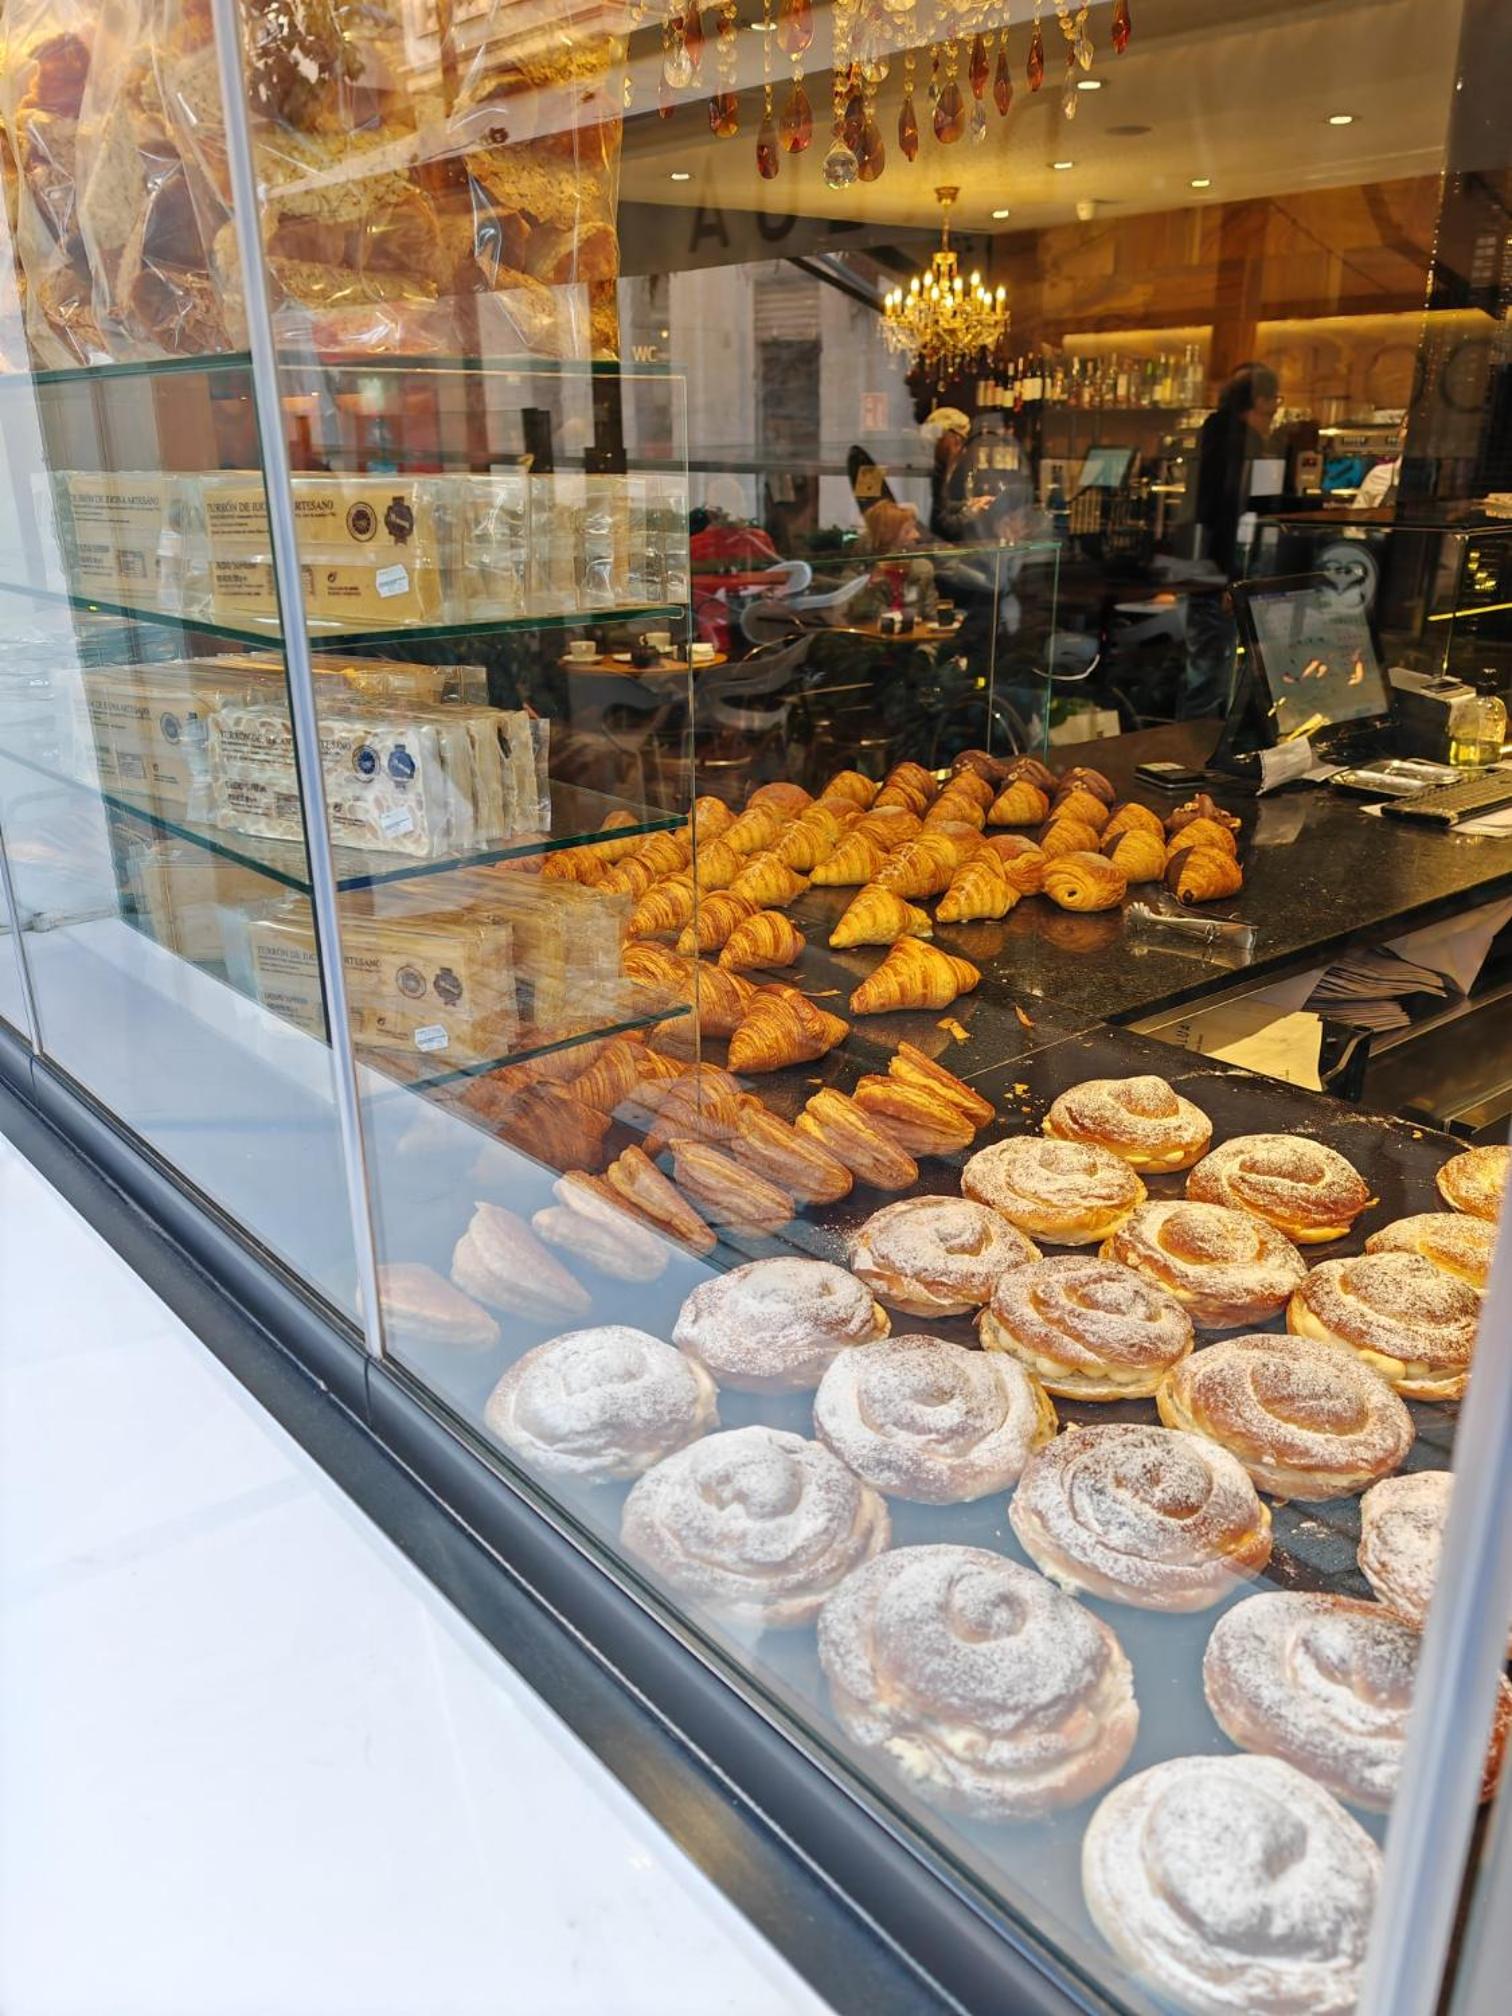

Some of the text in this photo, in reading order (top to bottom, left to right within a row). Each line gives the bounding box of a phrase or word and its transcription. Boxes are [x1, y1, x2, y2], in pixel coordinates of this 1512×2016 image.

[631, 345, 657, 363] WC
[294, 500, 334, 511] RTESANO
[344, 956, 381, 968] RTESANO
